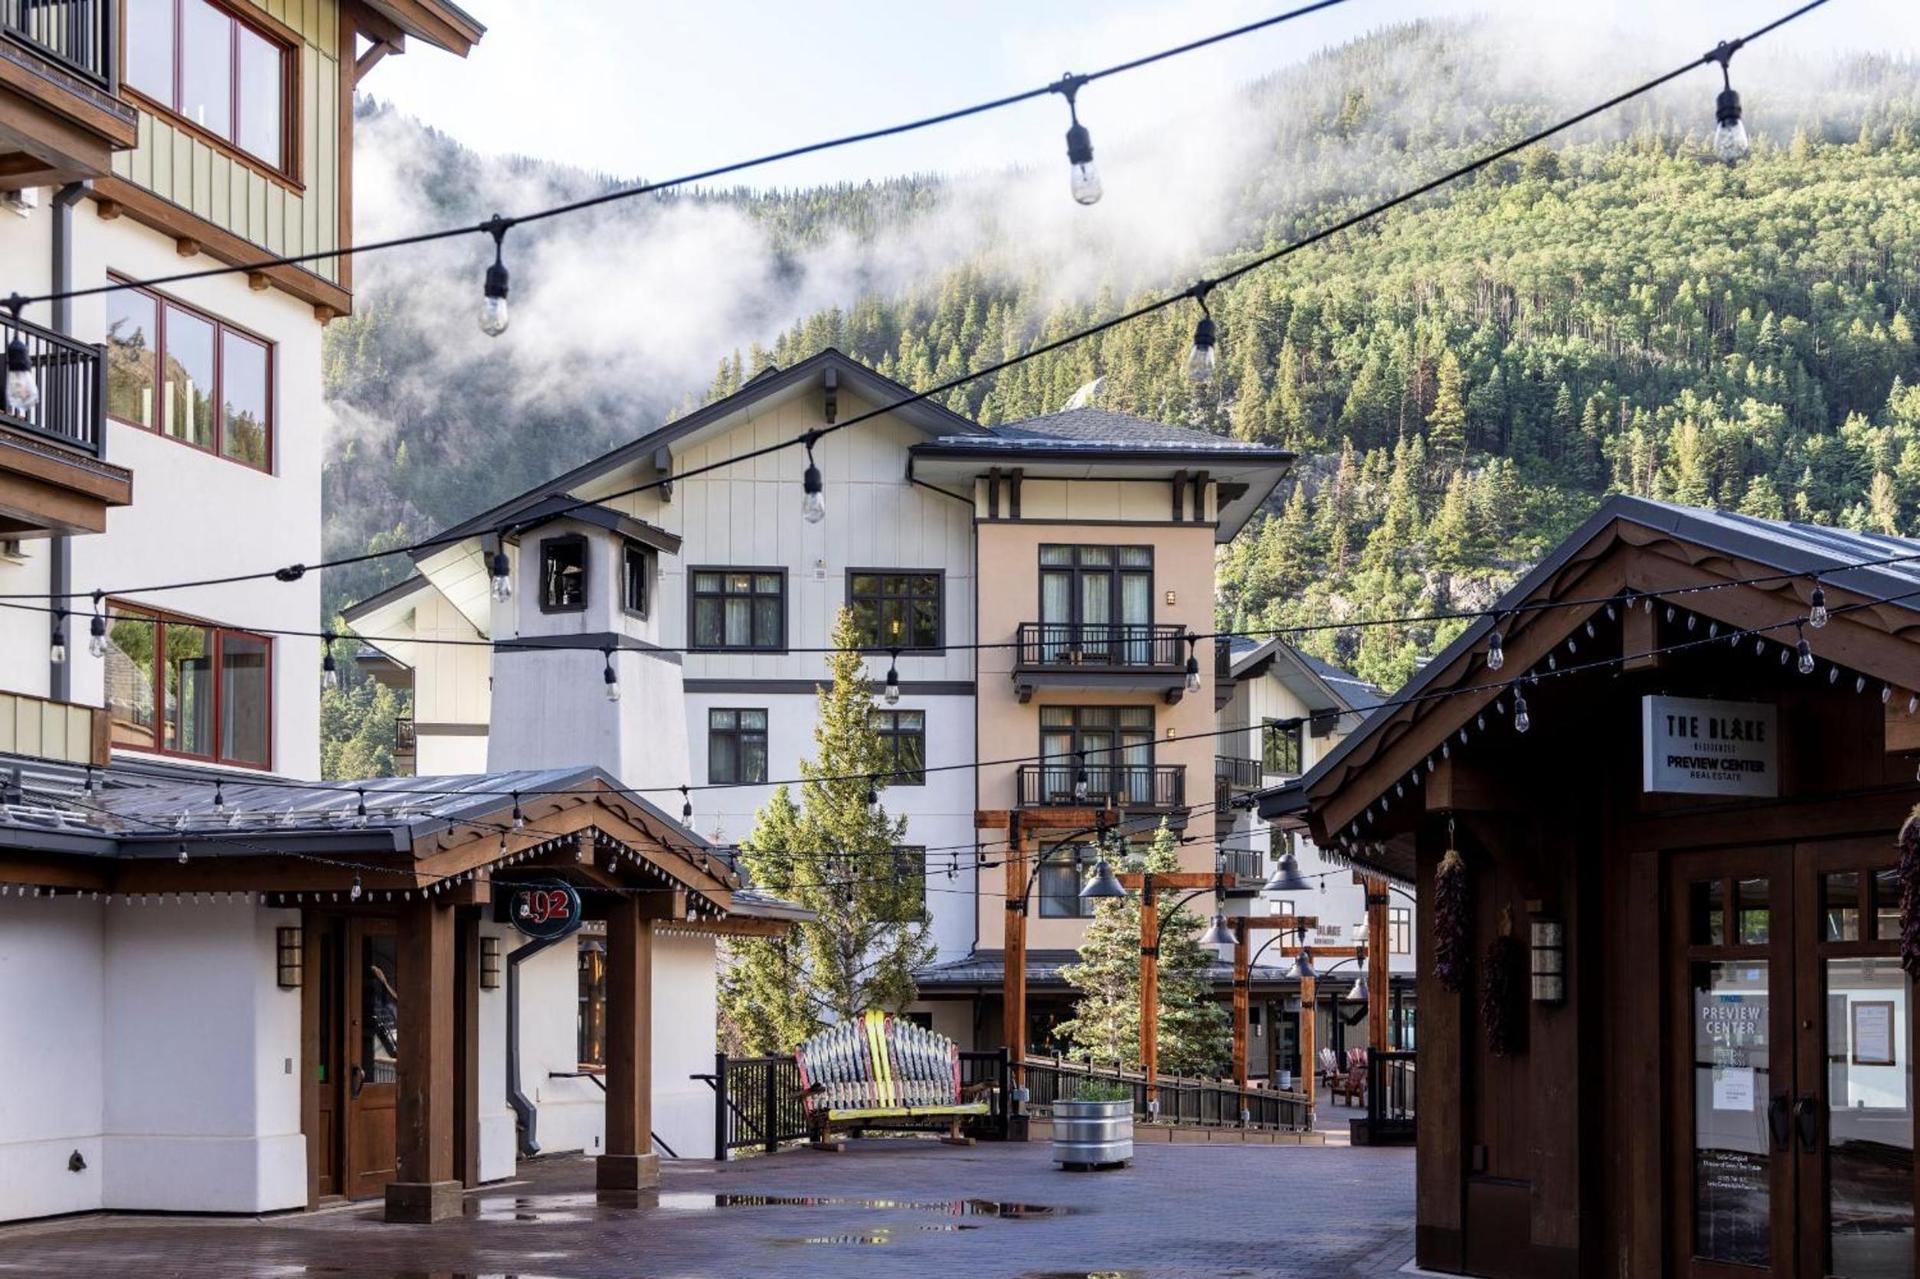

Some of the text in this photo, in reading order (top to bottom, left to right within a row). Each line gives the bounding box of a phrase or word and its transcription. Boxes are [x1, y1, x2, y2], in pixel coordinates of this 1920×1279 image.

[1667, 715, 1766, 742] THE BLAKE
[1667, 755, 1766, 773] PREVIEW CENTER
[1690, 771, 1742, 782] REAL ESTATE
[519, 889, 570, 924] 192
[1702, 1007, 1760, 1020] PREVIEW
[1706, 1022, 1756, 1035] CENTER
